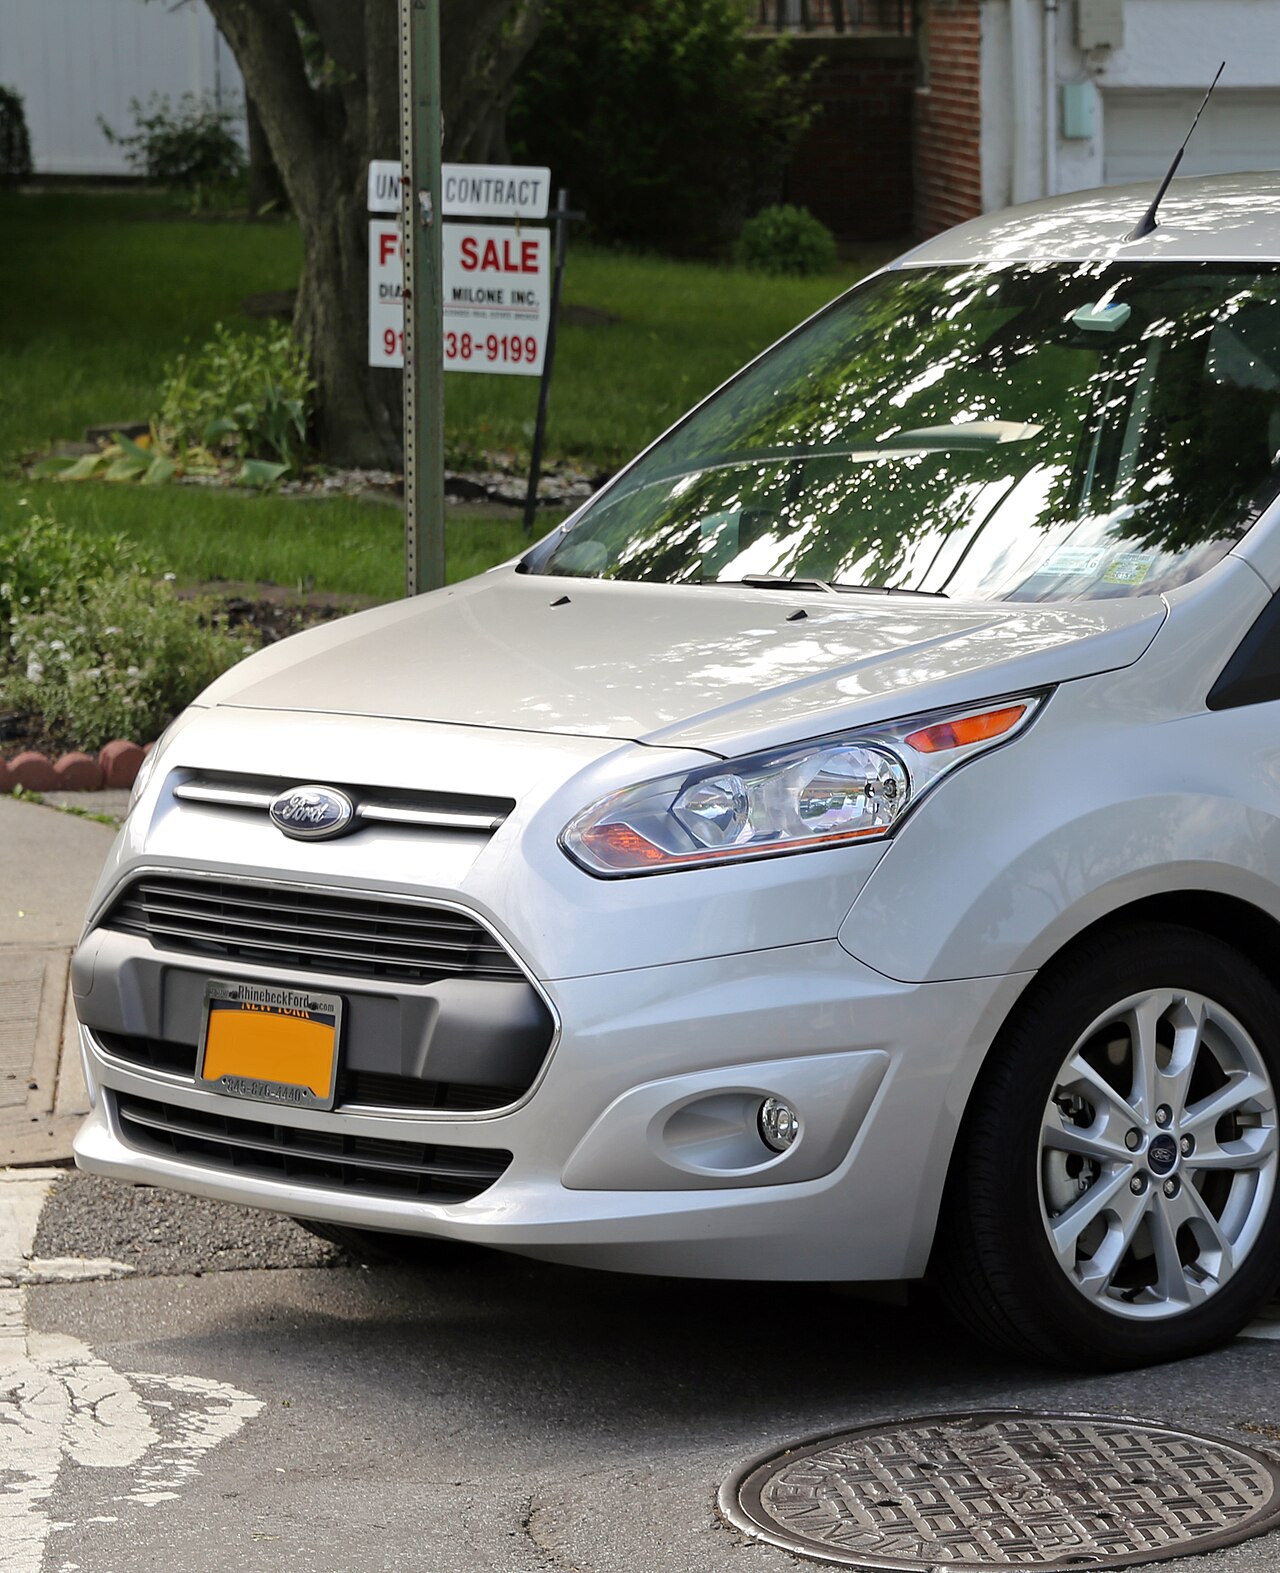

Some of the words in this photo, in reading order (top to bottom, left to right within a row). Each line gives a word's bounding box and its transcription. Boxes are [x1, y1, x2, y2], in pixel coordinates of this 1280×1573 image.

[446, 177, 541, 206] CONTRACT
[460, 237, 539, 274] SALE
[452, 287, 504, 305] MILONE
[511, 291, 540, 306] INC.
[280, 793, 329, 823] Ford
